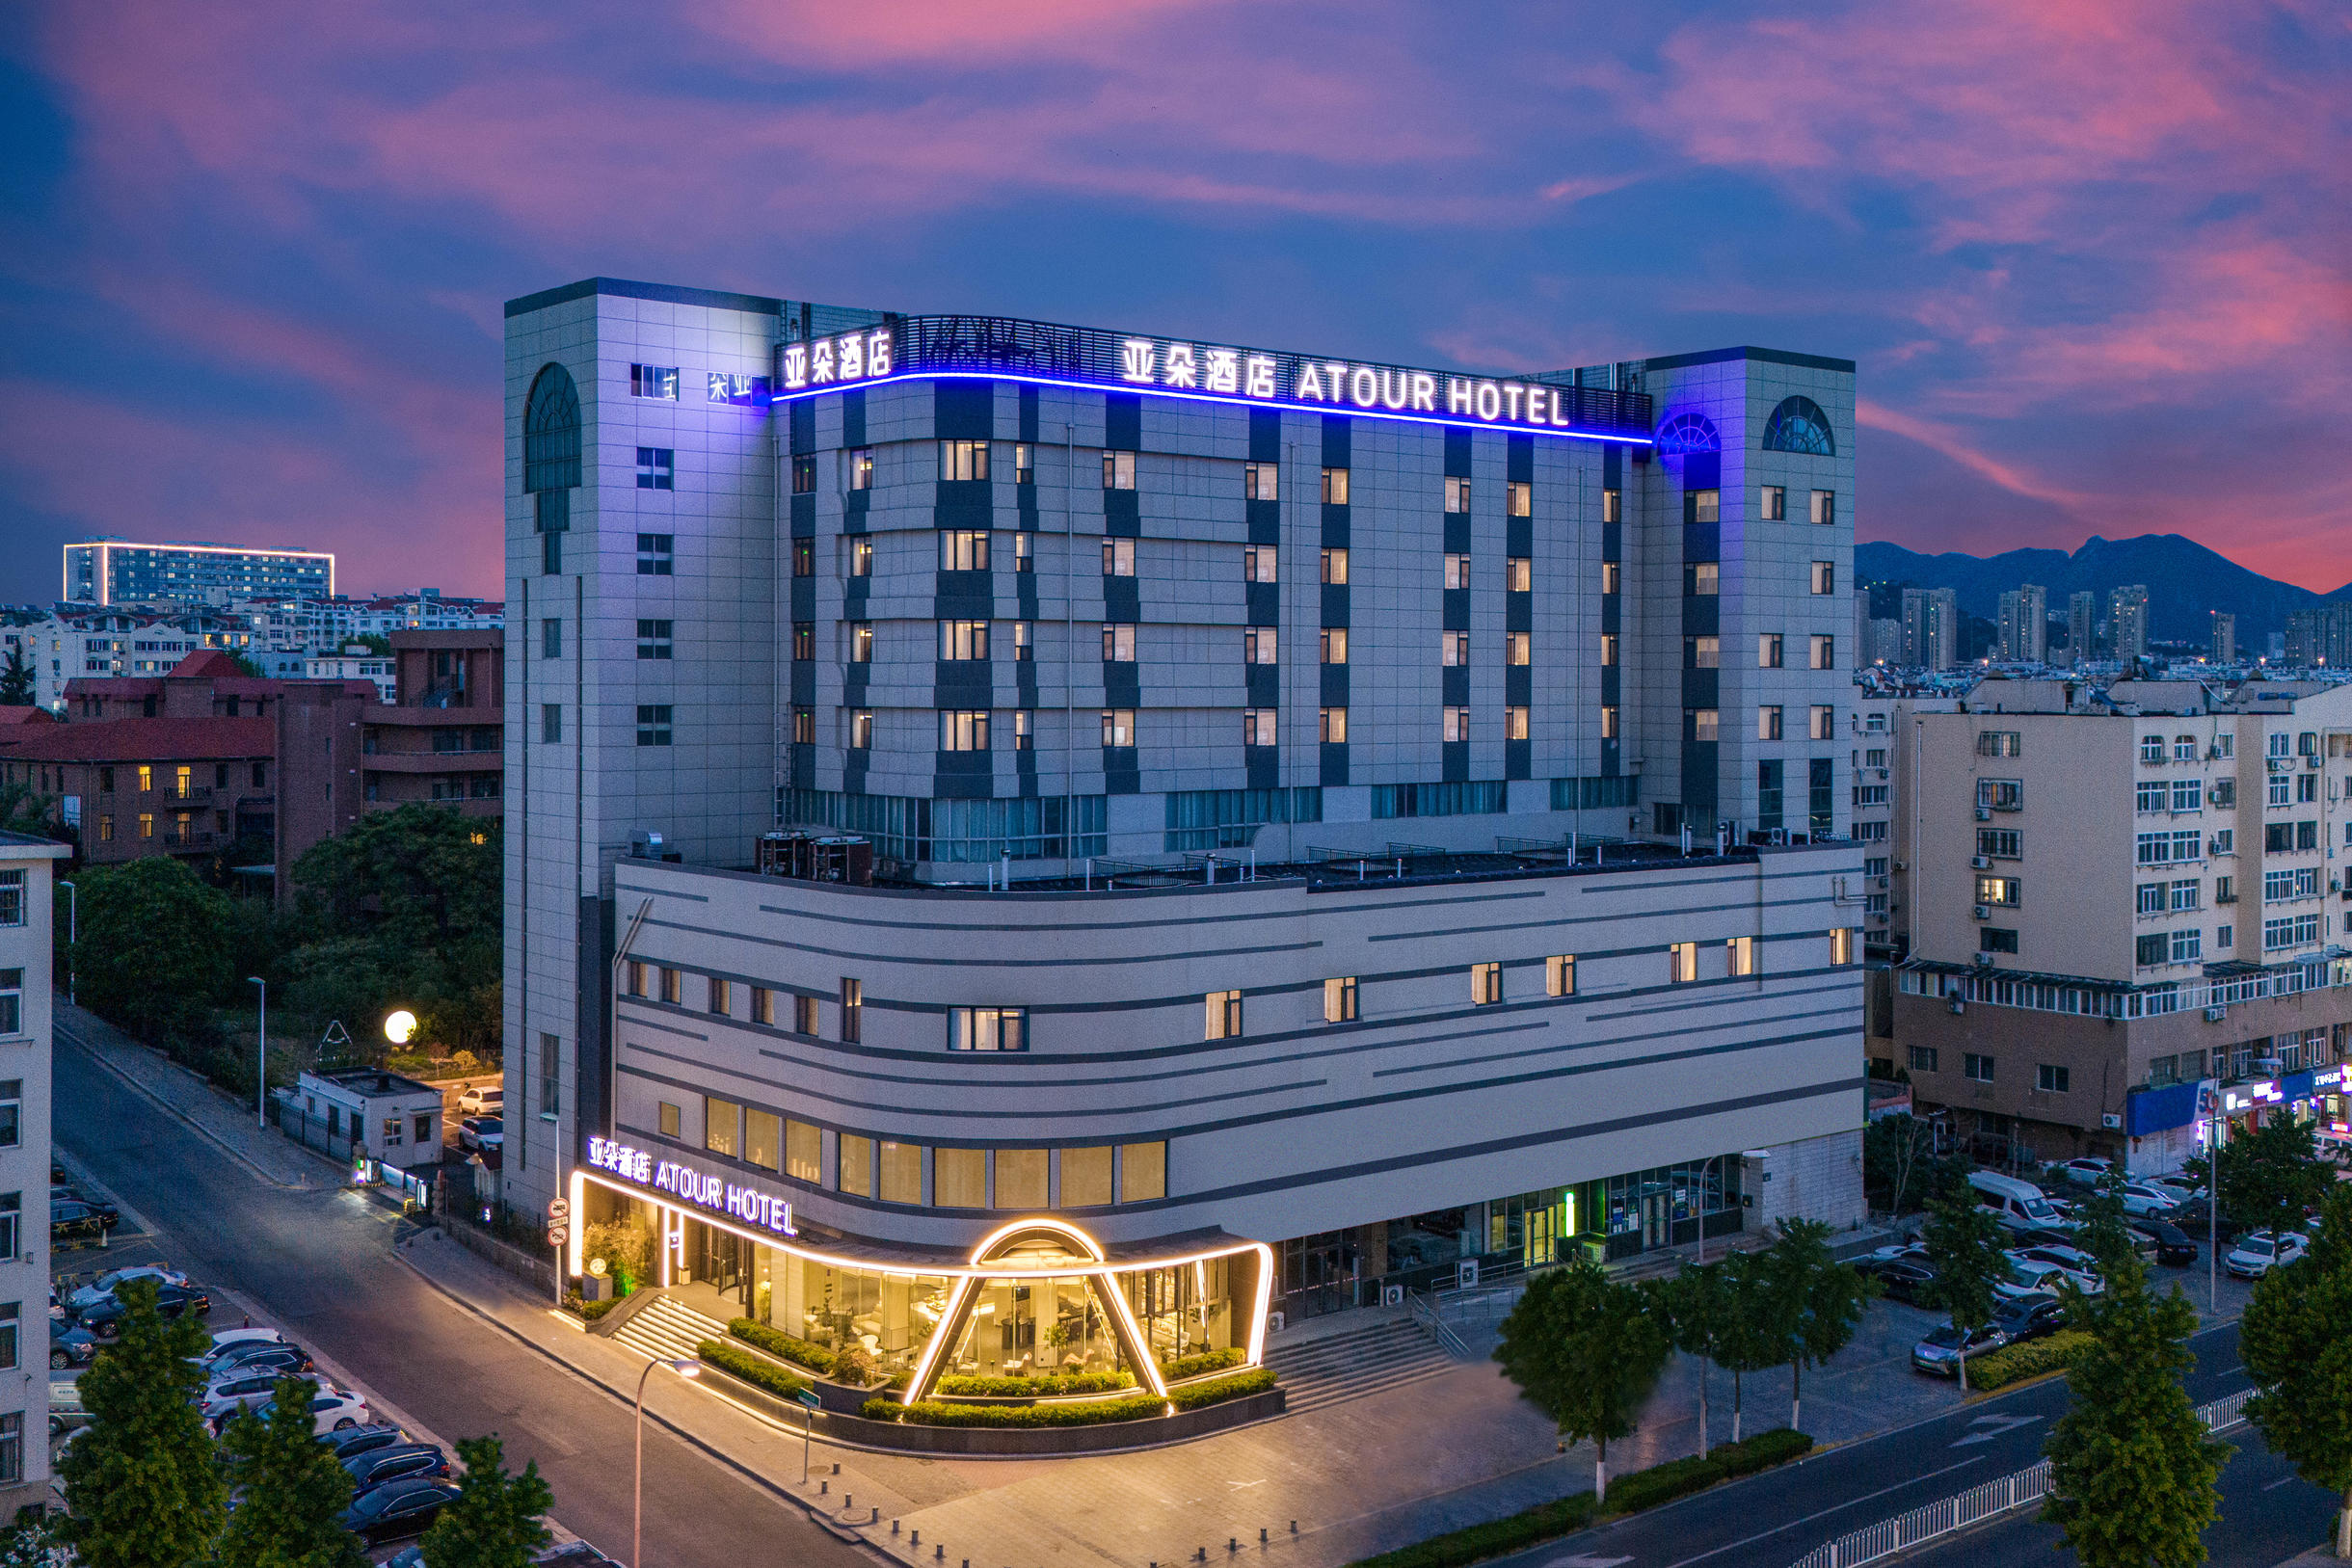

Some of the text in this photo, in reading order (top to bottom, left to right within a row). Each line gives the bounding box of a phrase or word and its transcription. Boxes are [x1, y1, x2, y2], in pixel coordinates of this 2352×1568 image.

[785, 331, 892, 388] 亚朵酒店
[1123, 339, 1569, 427] 亚朵酒店 ATOUR HOTEL
[588, 1136, 799, 1236] 亚朵酒店 ATOUR HOTEL
